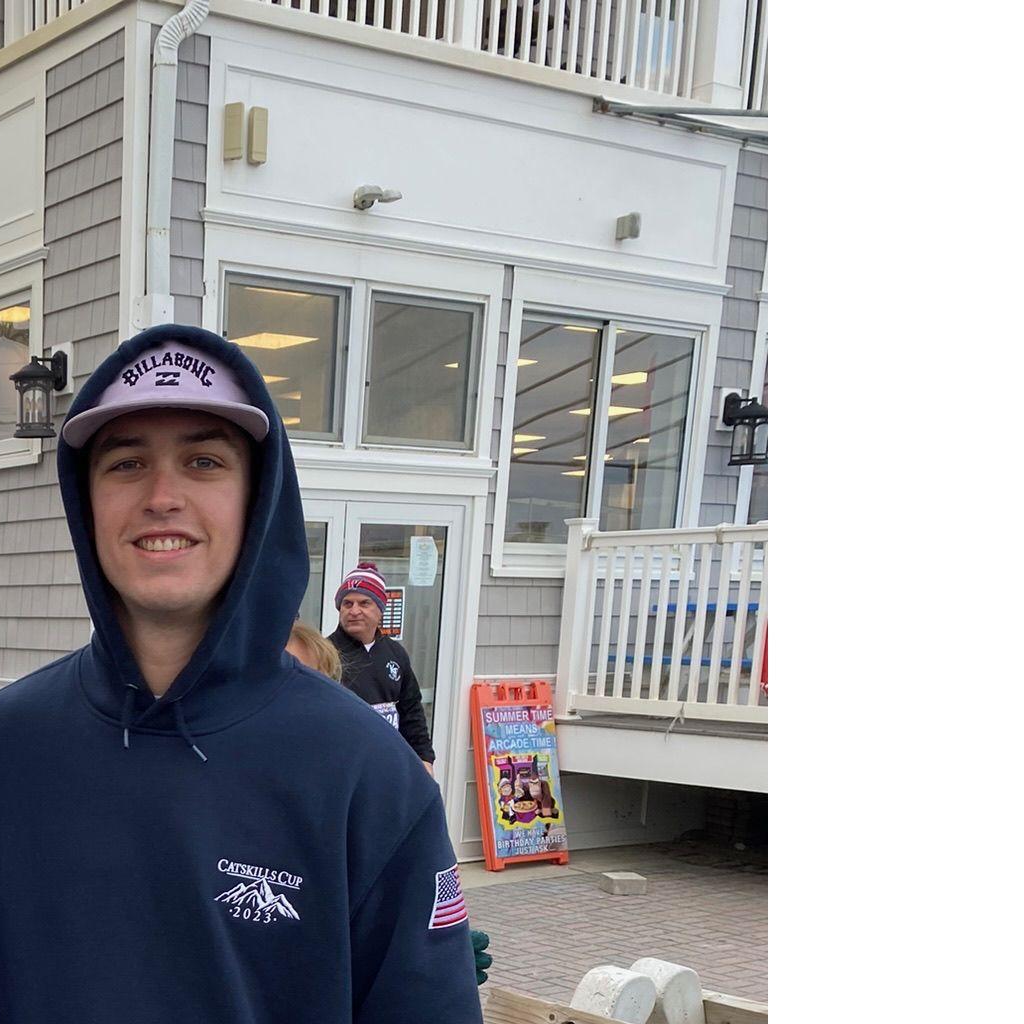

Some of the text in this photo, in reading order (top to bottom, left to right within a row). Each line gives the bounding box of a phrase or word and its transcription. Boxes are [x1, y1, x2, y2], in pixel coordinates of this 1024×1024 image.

[122, 352, 216, 387] BILLABONG
[485, 709, 553, 723] SUMMER TIME
[505, 723, 538, 735] MEANS
[488, 737, 530, 752] ARCADE
[497, 838, 534, 849] BIRTHDAY
[217, 858, 277, 881] CATSKILLS
